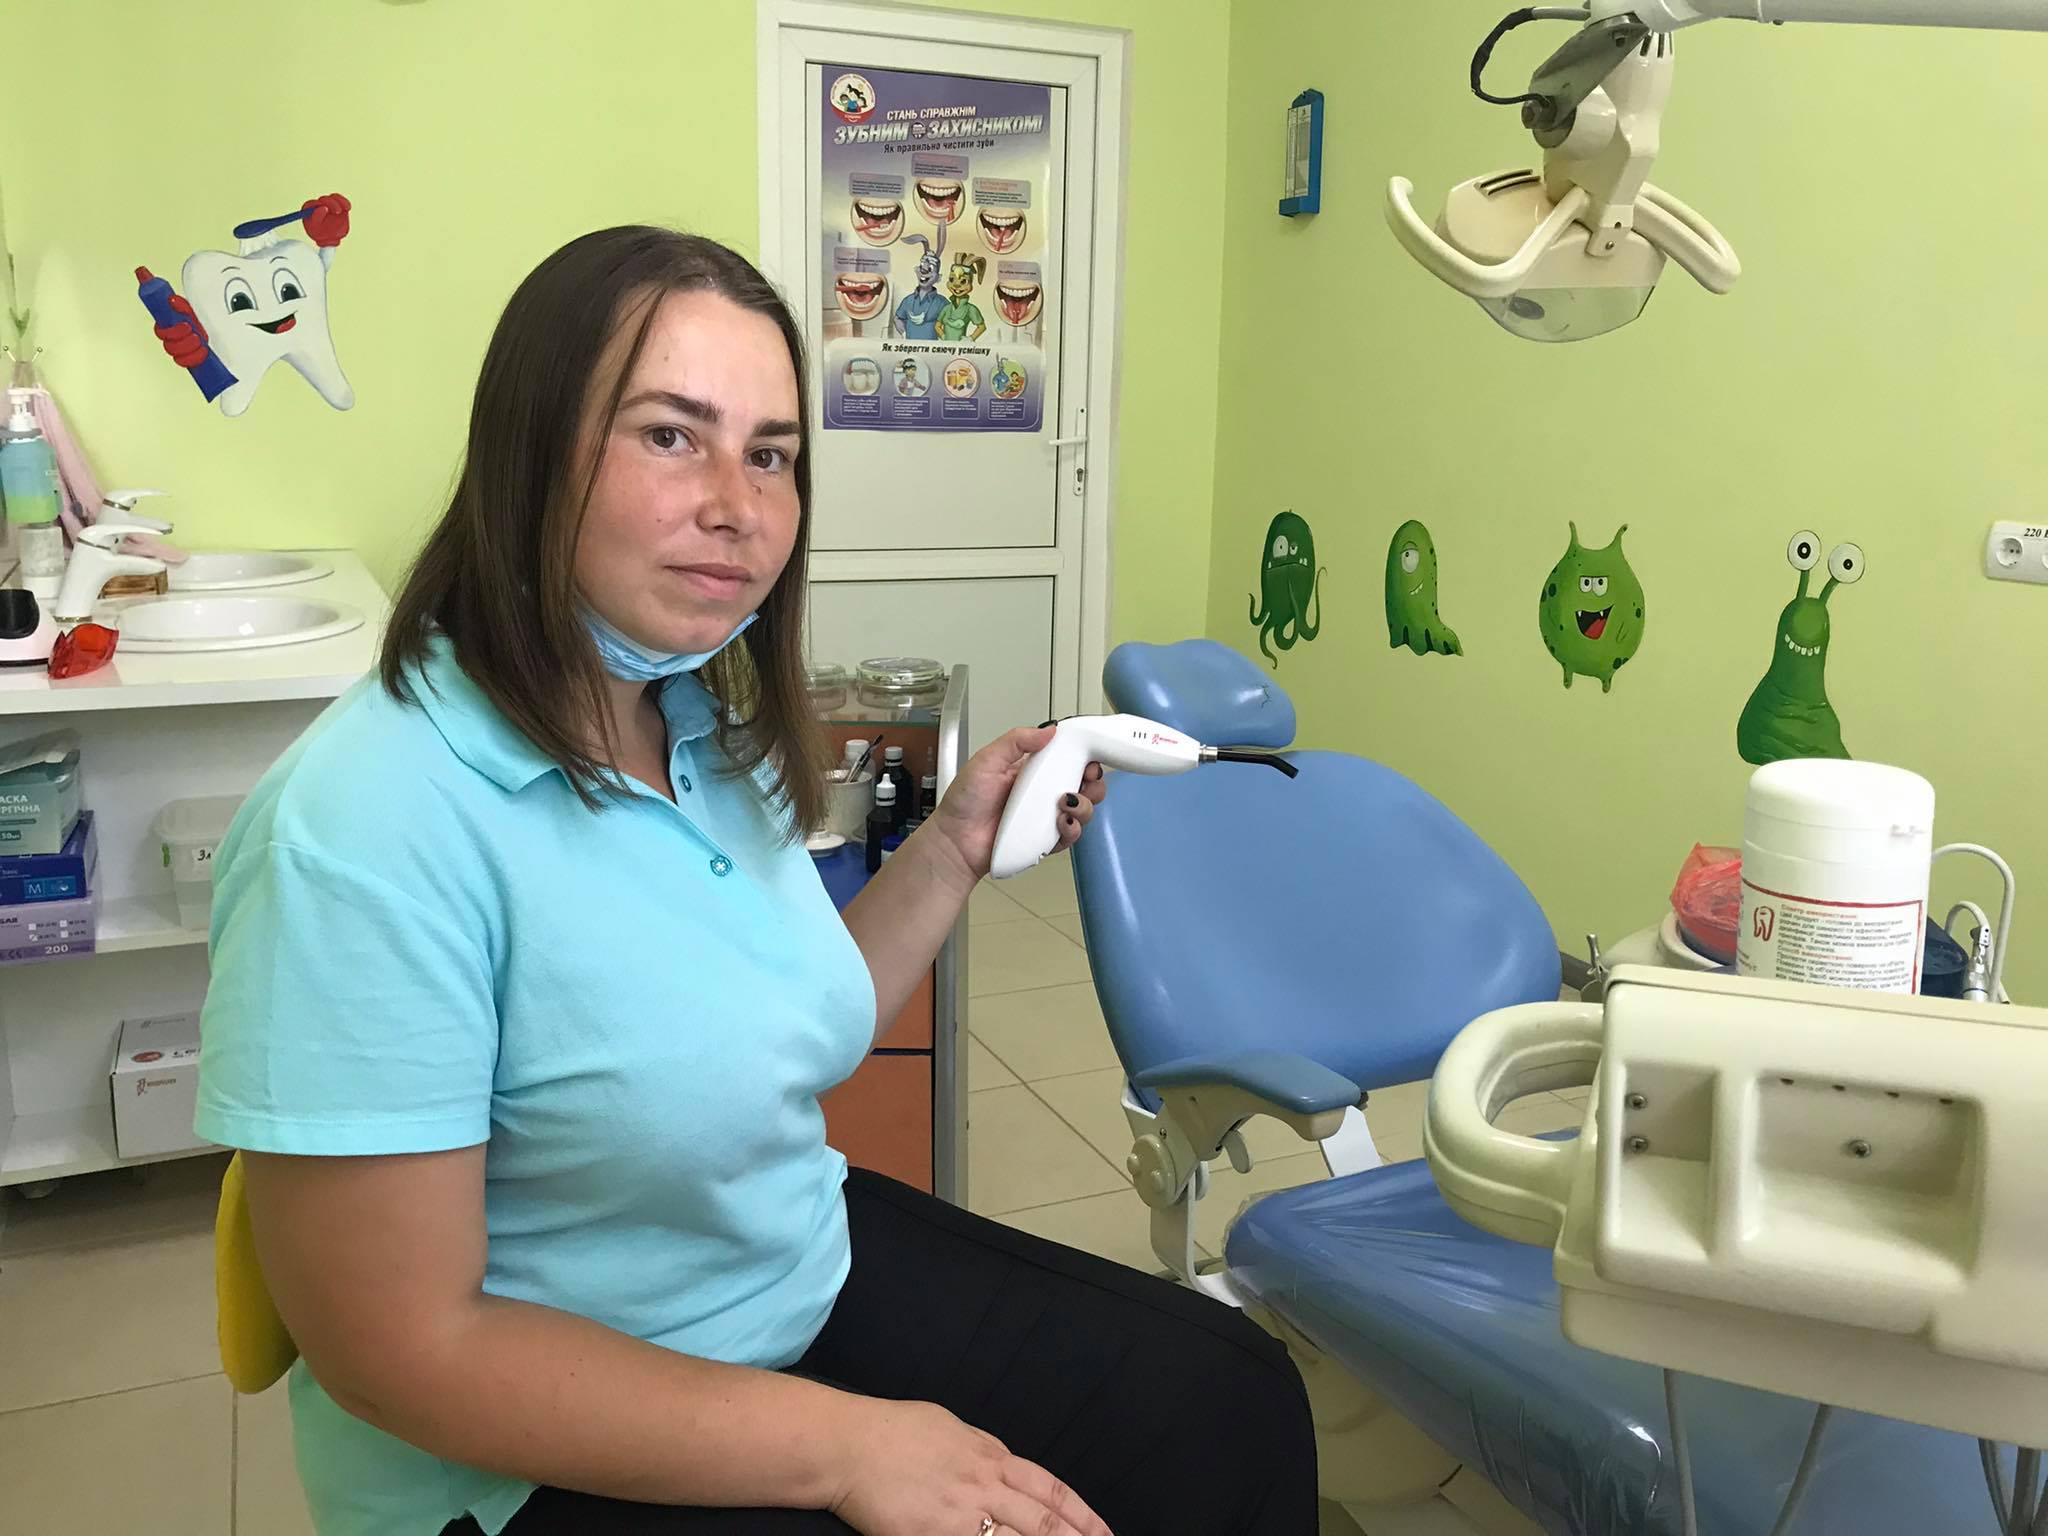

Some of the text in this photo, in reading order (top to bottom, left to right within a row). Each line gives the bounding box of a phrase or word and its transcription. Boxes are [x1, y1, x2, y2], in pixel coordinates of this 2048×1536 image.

[887, 106, 976, 120] СТАНЬ СПРАВЖНІМ
[833, 114, 1043, 145] ЗУБНИМ ЗАХИСНИКОМ!
[884, 139, 995, 154] Як правильно чистити зуби
[882, 344, 991, 356] Як зберегти сяючу усмішку
[2024, 528, 2042, 538] 220
[0, 795, 28, 804] АСКА
[1, 804, 41, 814] РГІЧНА
[28, 884, 42, 894] M
[45, 944, 69, 954] 200
